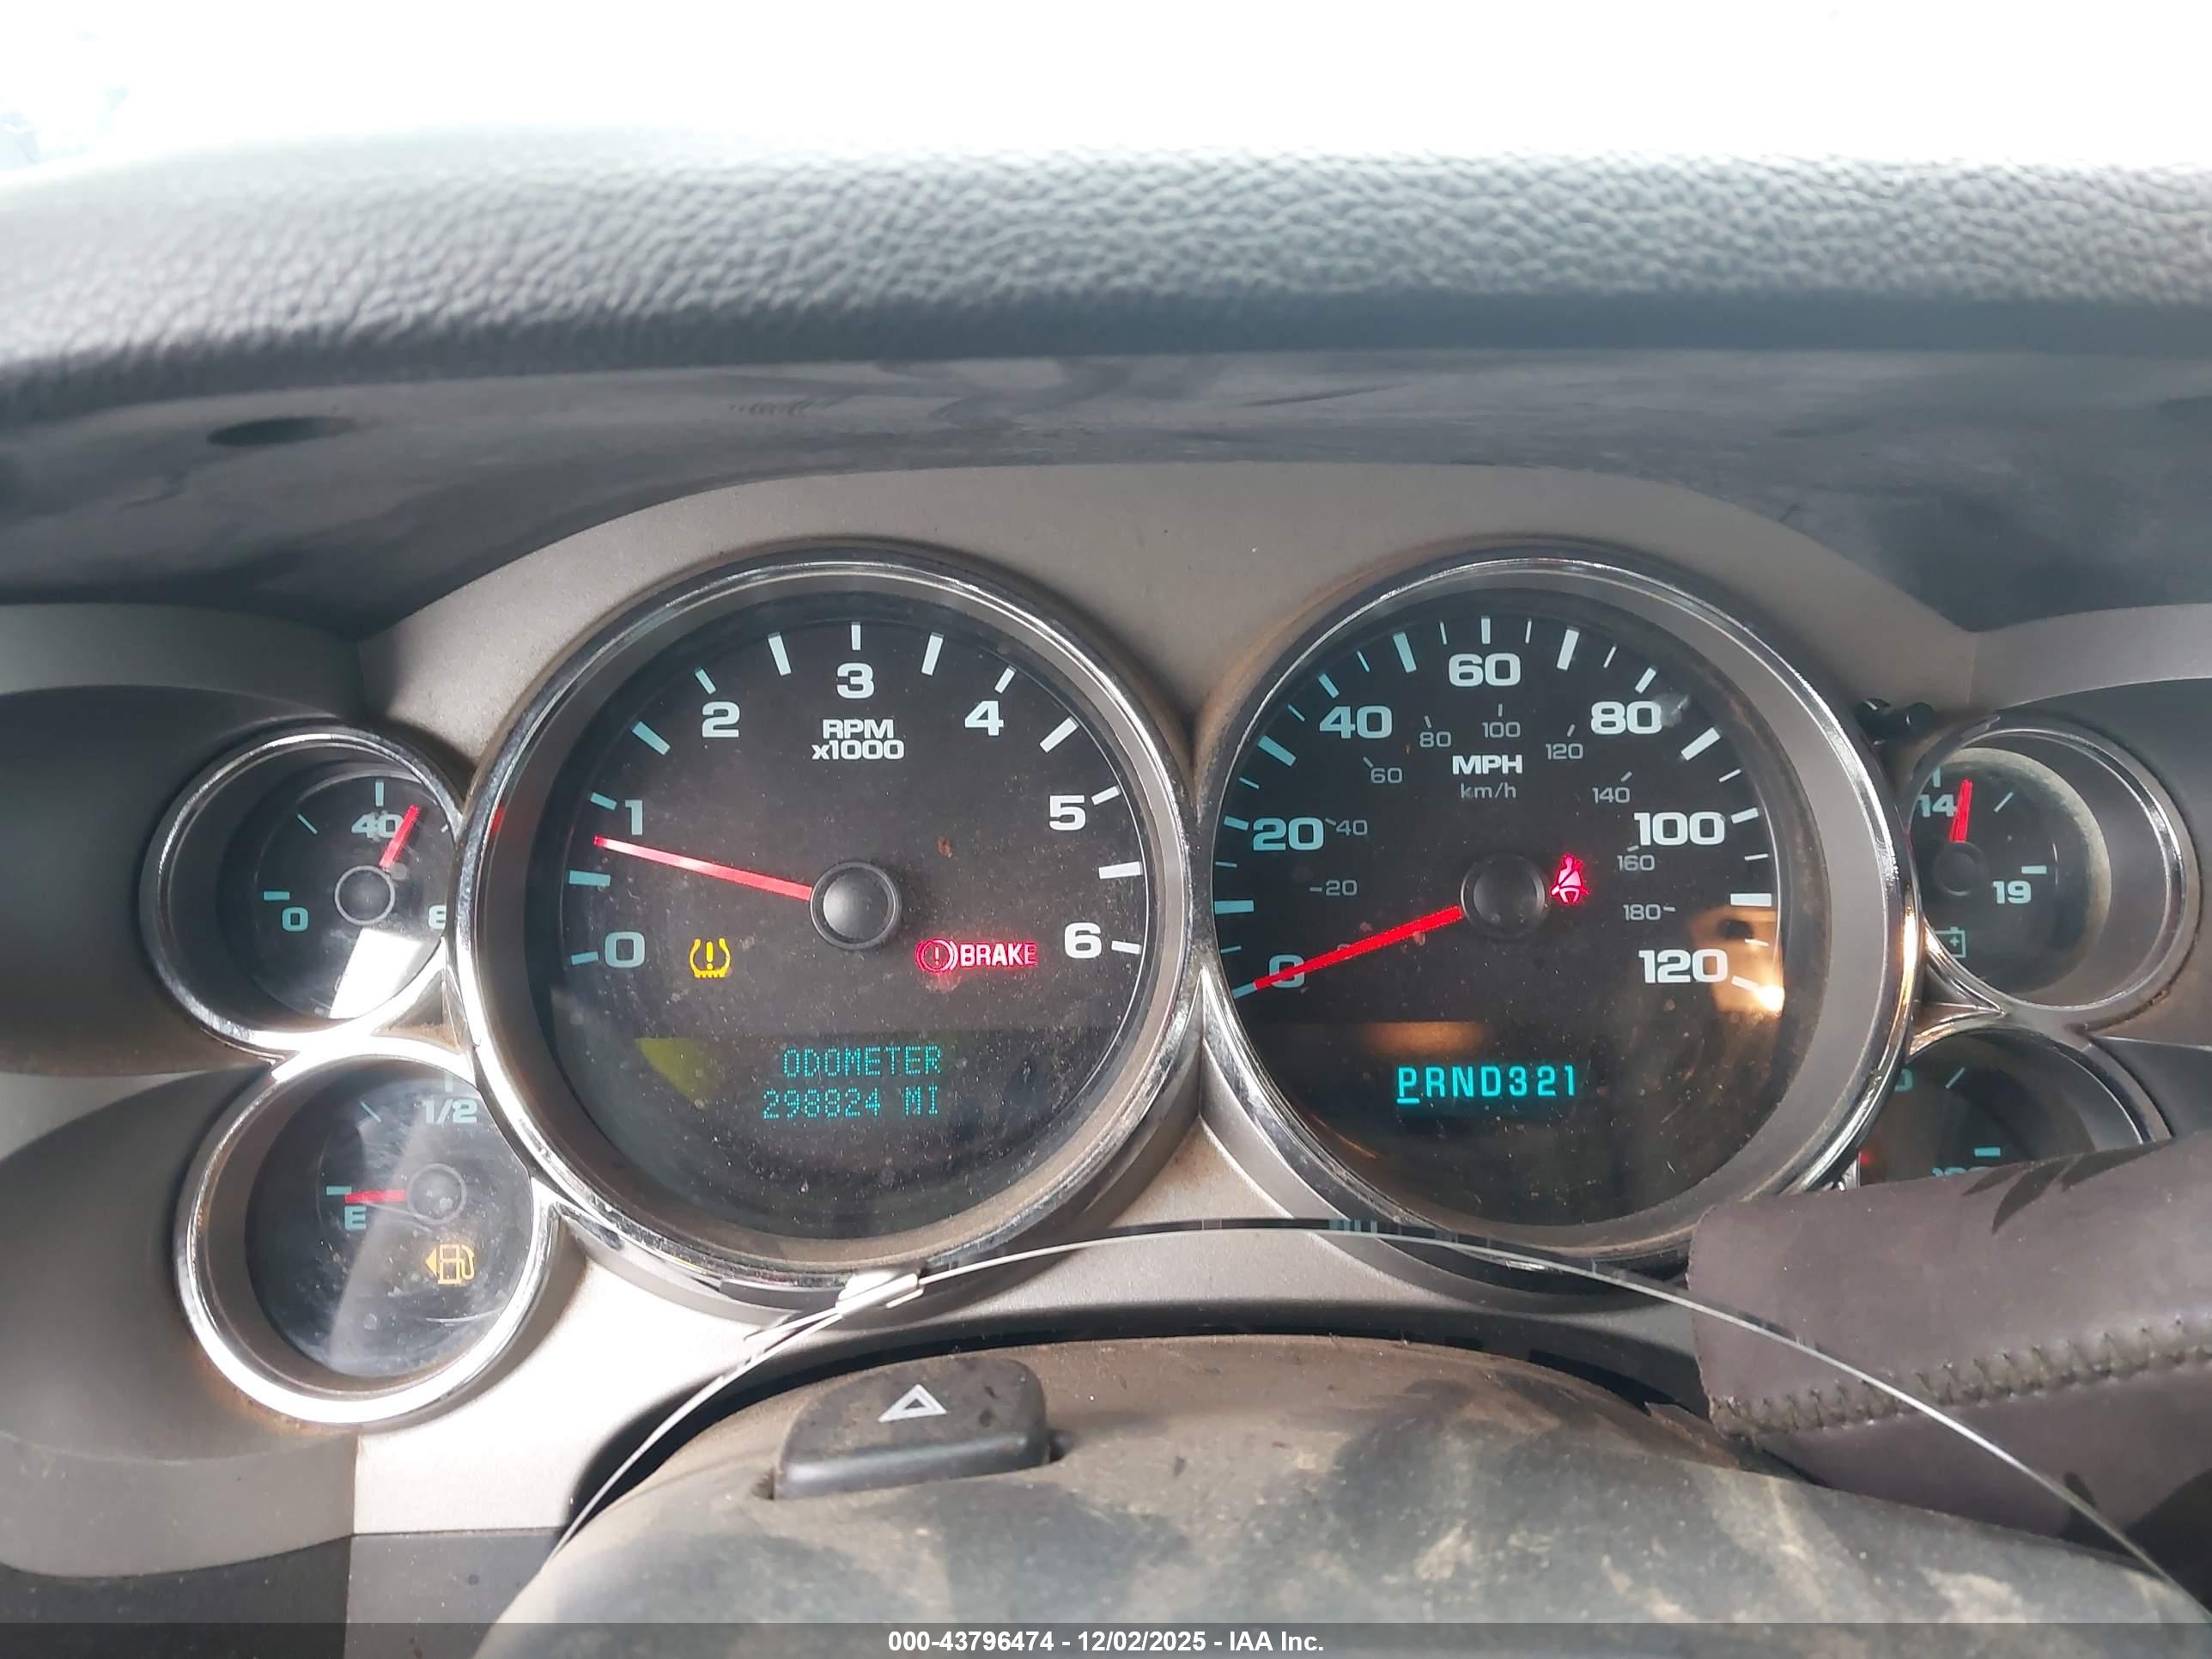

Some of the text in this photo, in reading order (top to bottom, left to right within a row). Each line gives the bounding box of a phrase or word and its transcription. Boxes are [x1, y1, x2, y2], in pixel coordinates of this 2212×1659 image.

[837, 663, 874, 698] 3
[1449, 653, 1520, 686] 60
[702, 702, 739, 737] 2
[823, 720, 893, 738] RPM
[965, 701, 1004, 735] 4
[1320, 706, 1392, 738] 40
[1483, 722, 1520, 738] 100
[1591, 702, 1660, 734] 80
[812, 741, 903, 759] x1000
[1420, 732, 1451, 747] 80
[1546, 744, 1583, 759] 120
[1370, 768, 1402, 783] 60
[1453, 755, 1522, 774] MPH
[1461, 782, 1516, 798] km/h
[1593, 787, 1630, 803] 140
[625, 800, 642, 835] 1
[1050, 795, 1085, 830] 5
[1918, 794, 1958, 818] 14
[352, 813, 404, 839] 40
[1254, 817, 1323, 850] 20
[1335, 820, 1367, 836] 40
[1634, 812, 1724, 845] 100
[1618, 855, 1655, 871] 160
[1326, 880, 1357, 896] 20
[1993, 881, 2031, 903] 19
[283, 908, 308, 931] 0
[1624, 904, 1661, 920] 180
[605, 932, 645, 967] 0
[1065, 923, 1102, 958] 6
[960, 942, 1037, 967] BRAKE
[1639, 950, 1728, 983] 120
[1269, 954, 1304, 988] 0
[784, 1046, 940, 1078] ODOMETER
[423, 1098, 477, 1123] 1/2
[764, 1085, 937, 1118] 298824 MI
[345, 1206, 366, 1230] E
